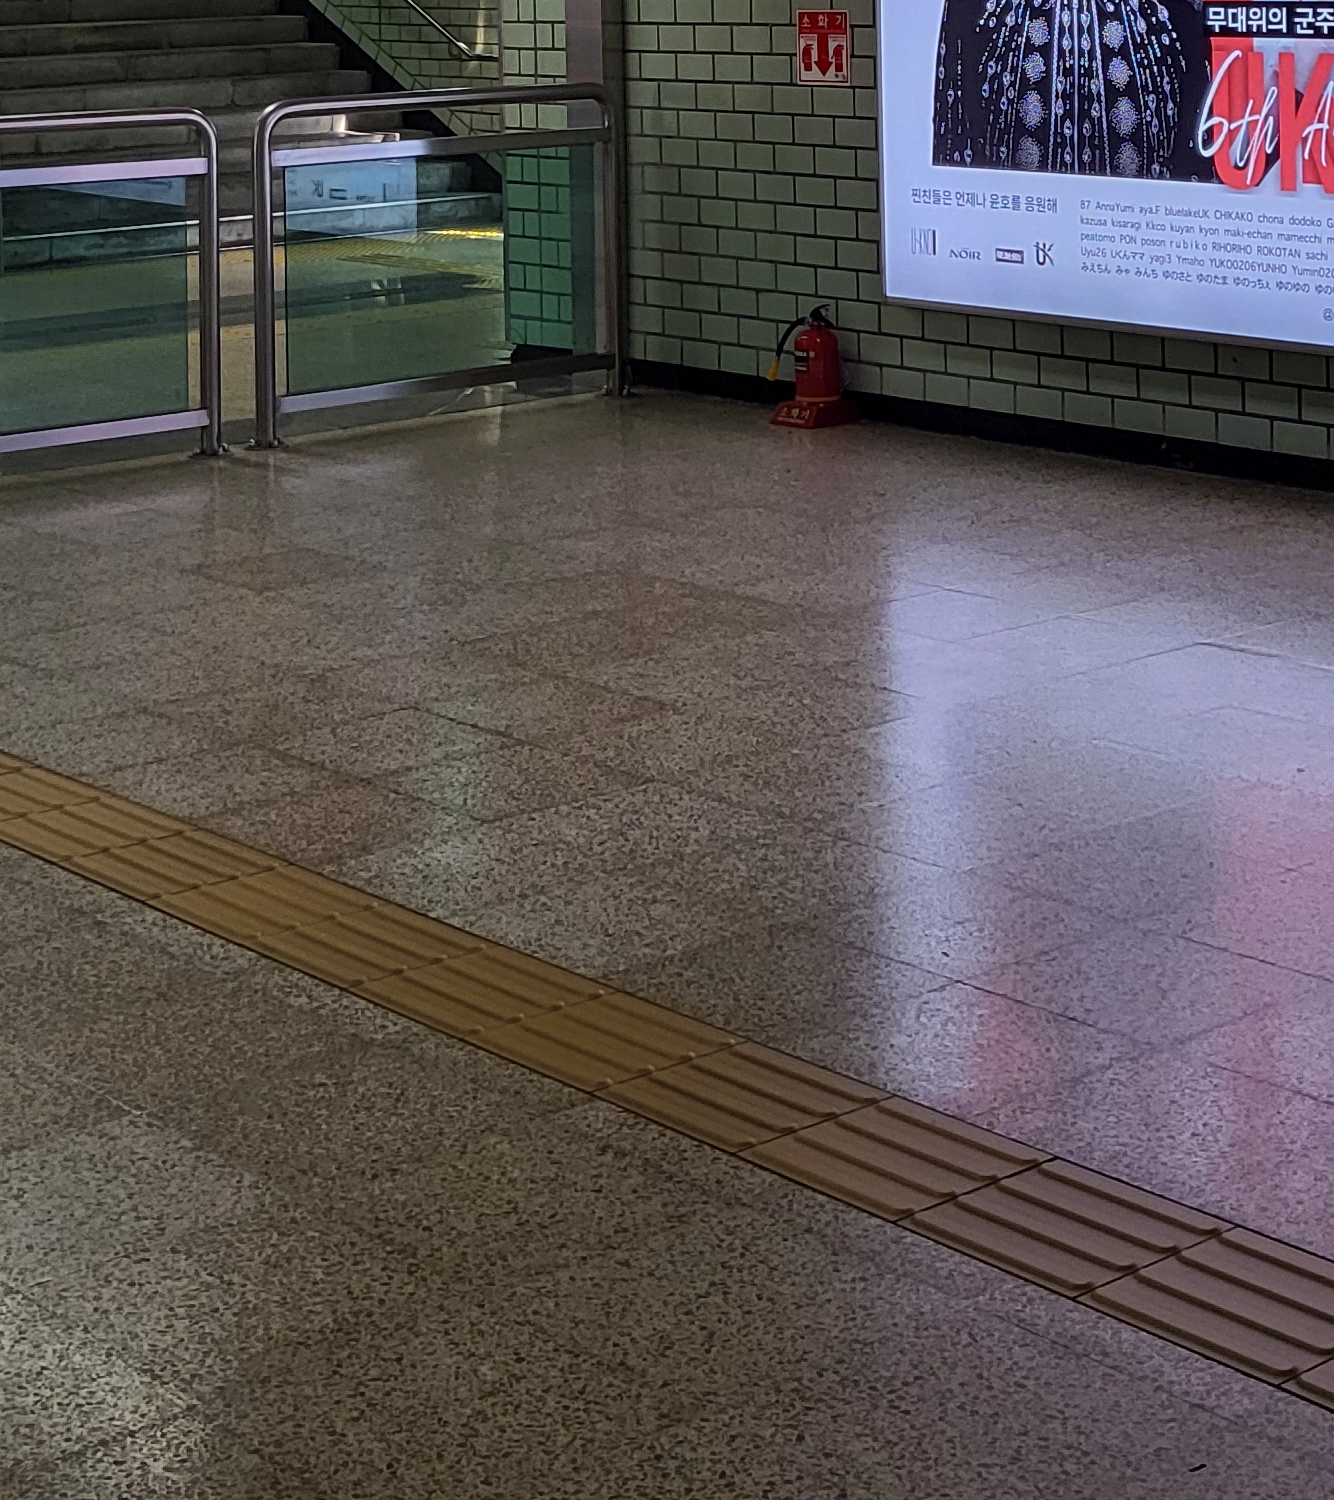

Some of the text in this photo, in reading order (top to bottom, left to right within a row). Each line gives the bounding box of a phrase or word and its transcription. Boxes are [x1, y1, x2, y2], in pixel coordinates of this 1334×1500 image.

[800, 13, 845, 29] 소화기
[1206, 6, 1288, 34] 무대위의
[1197, 49, 1281, 186] 6th
[911, 188, 1058, 214] 찐친들은 언제나 윤호를 응원해
[1080, 199, 1091, 209] 87
